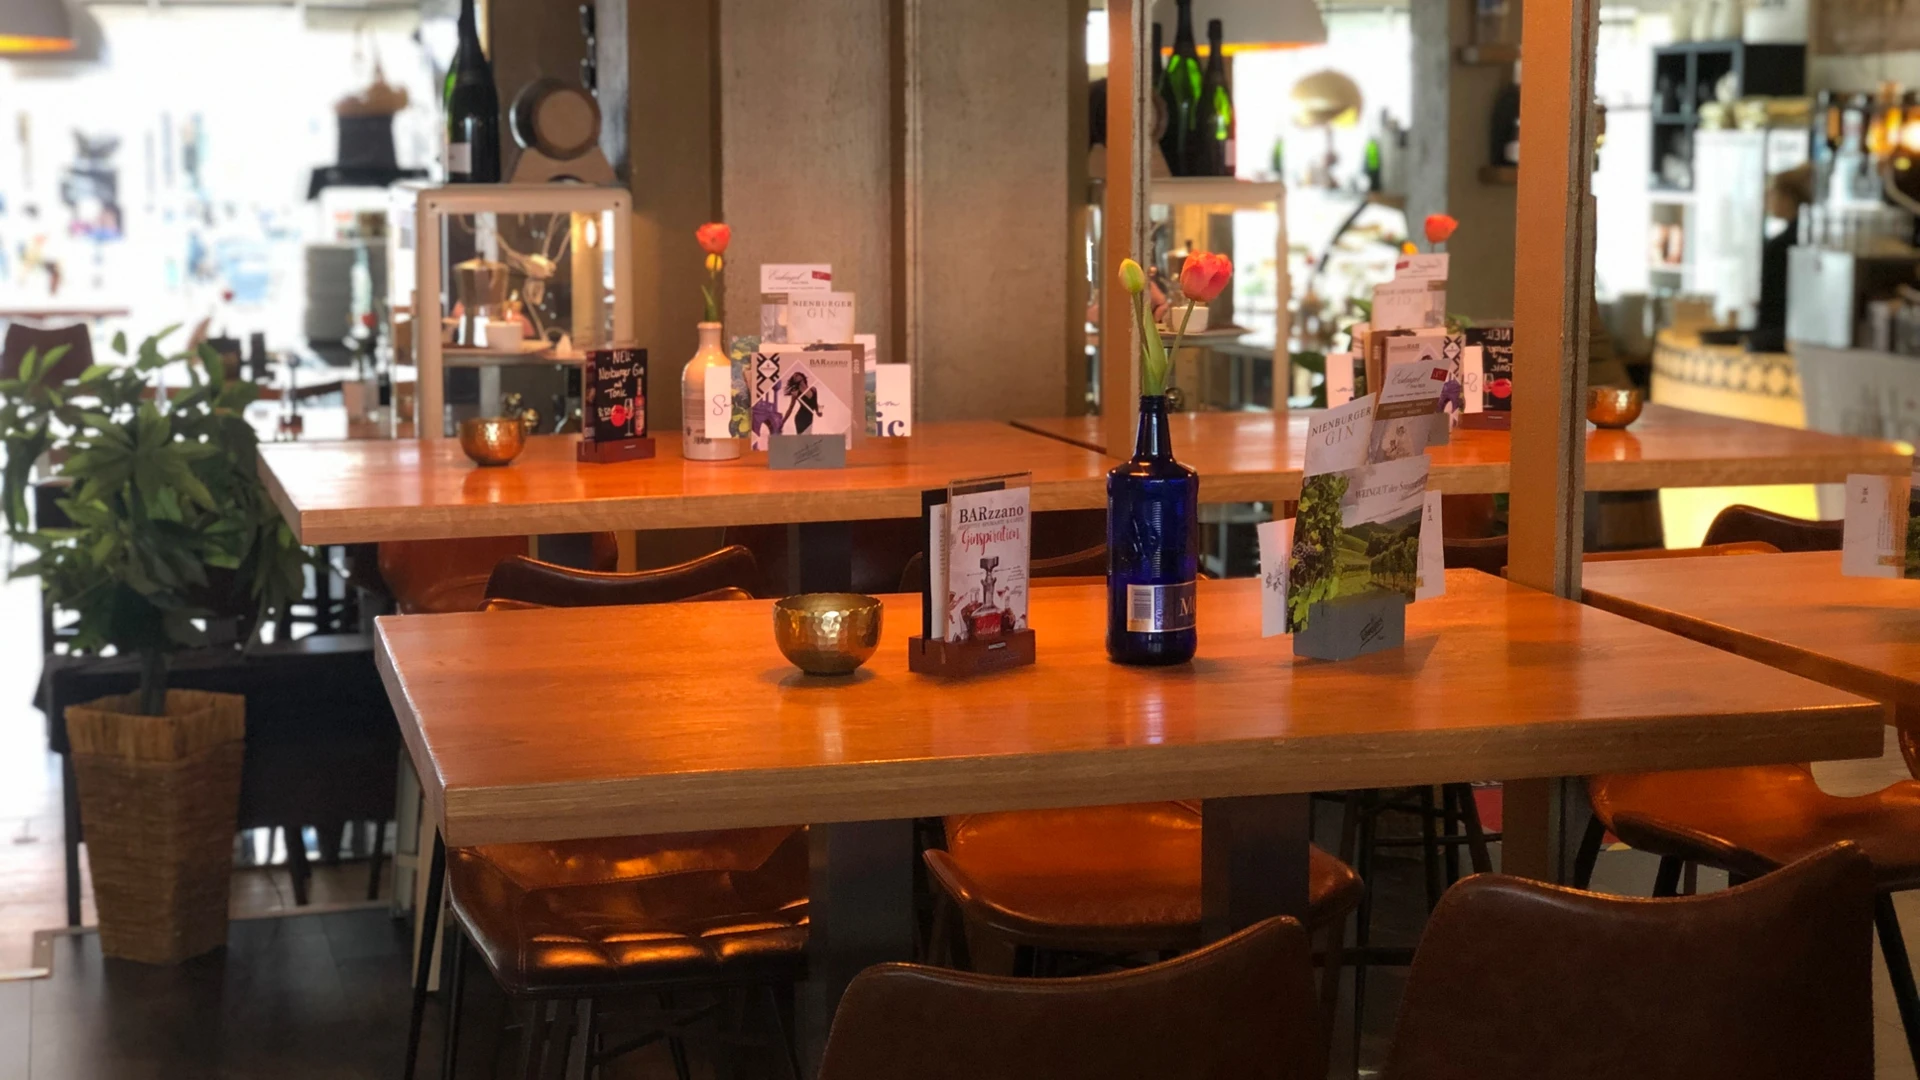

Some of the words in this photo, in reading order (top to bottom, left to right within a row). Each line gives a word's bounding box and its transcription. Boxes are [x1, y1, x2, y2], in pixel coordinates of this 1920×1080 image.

[806, 308, 837, 319] GIN
[809, 358, 849, 366] BARzzano
[1311, 406, 1372, 436] NIENBURGER
[1325, 424, 1355, 446] GIN
[959, 505, 1024, 524] BARzzano
